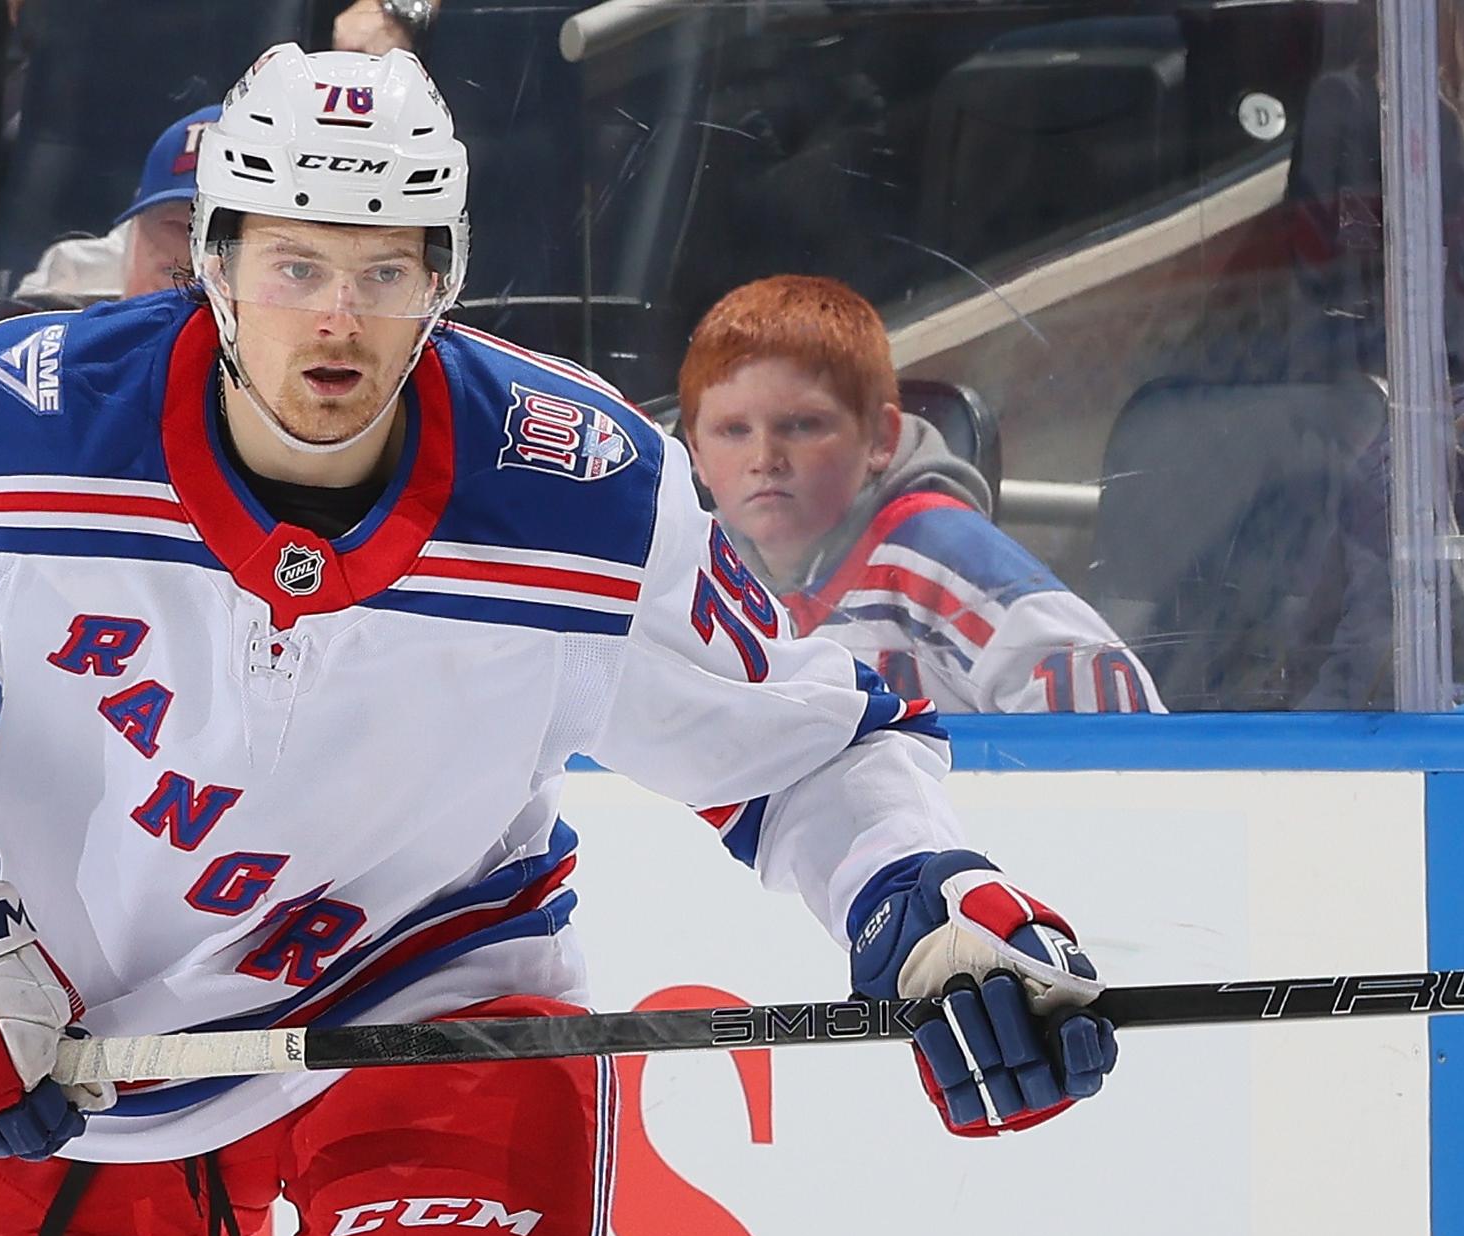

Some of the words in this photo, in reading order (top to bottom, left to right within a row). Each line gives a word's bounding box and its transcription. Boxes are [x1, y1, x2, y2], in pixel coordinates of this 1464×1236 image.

[296, 153, 388, 174] CCM
[38, 324, 65, 411] GAME
[515, 395, 584, 472] 100
[284, 561, 314, 581] NHL
[690, 517, 779, 683] 78
[1033, 642, 1150, 713] 10
[45, 612, 374, 989] RANGR
[855, 900, 891, 954] CCM
